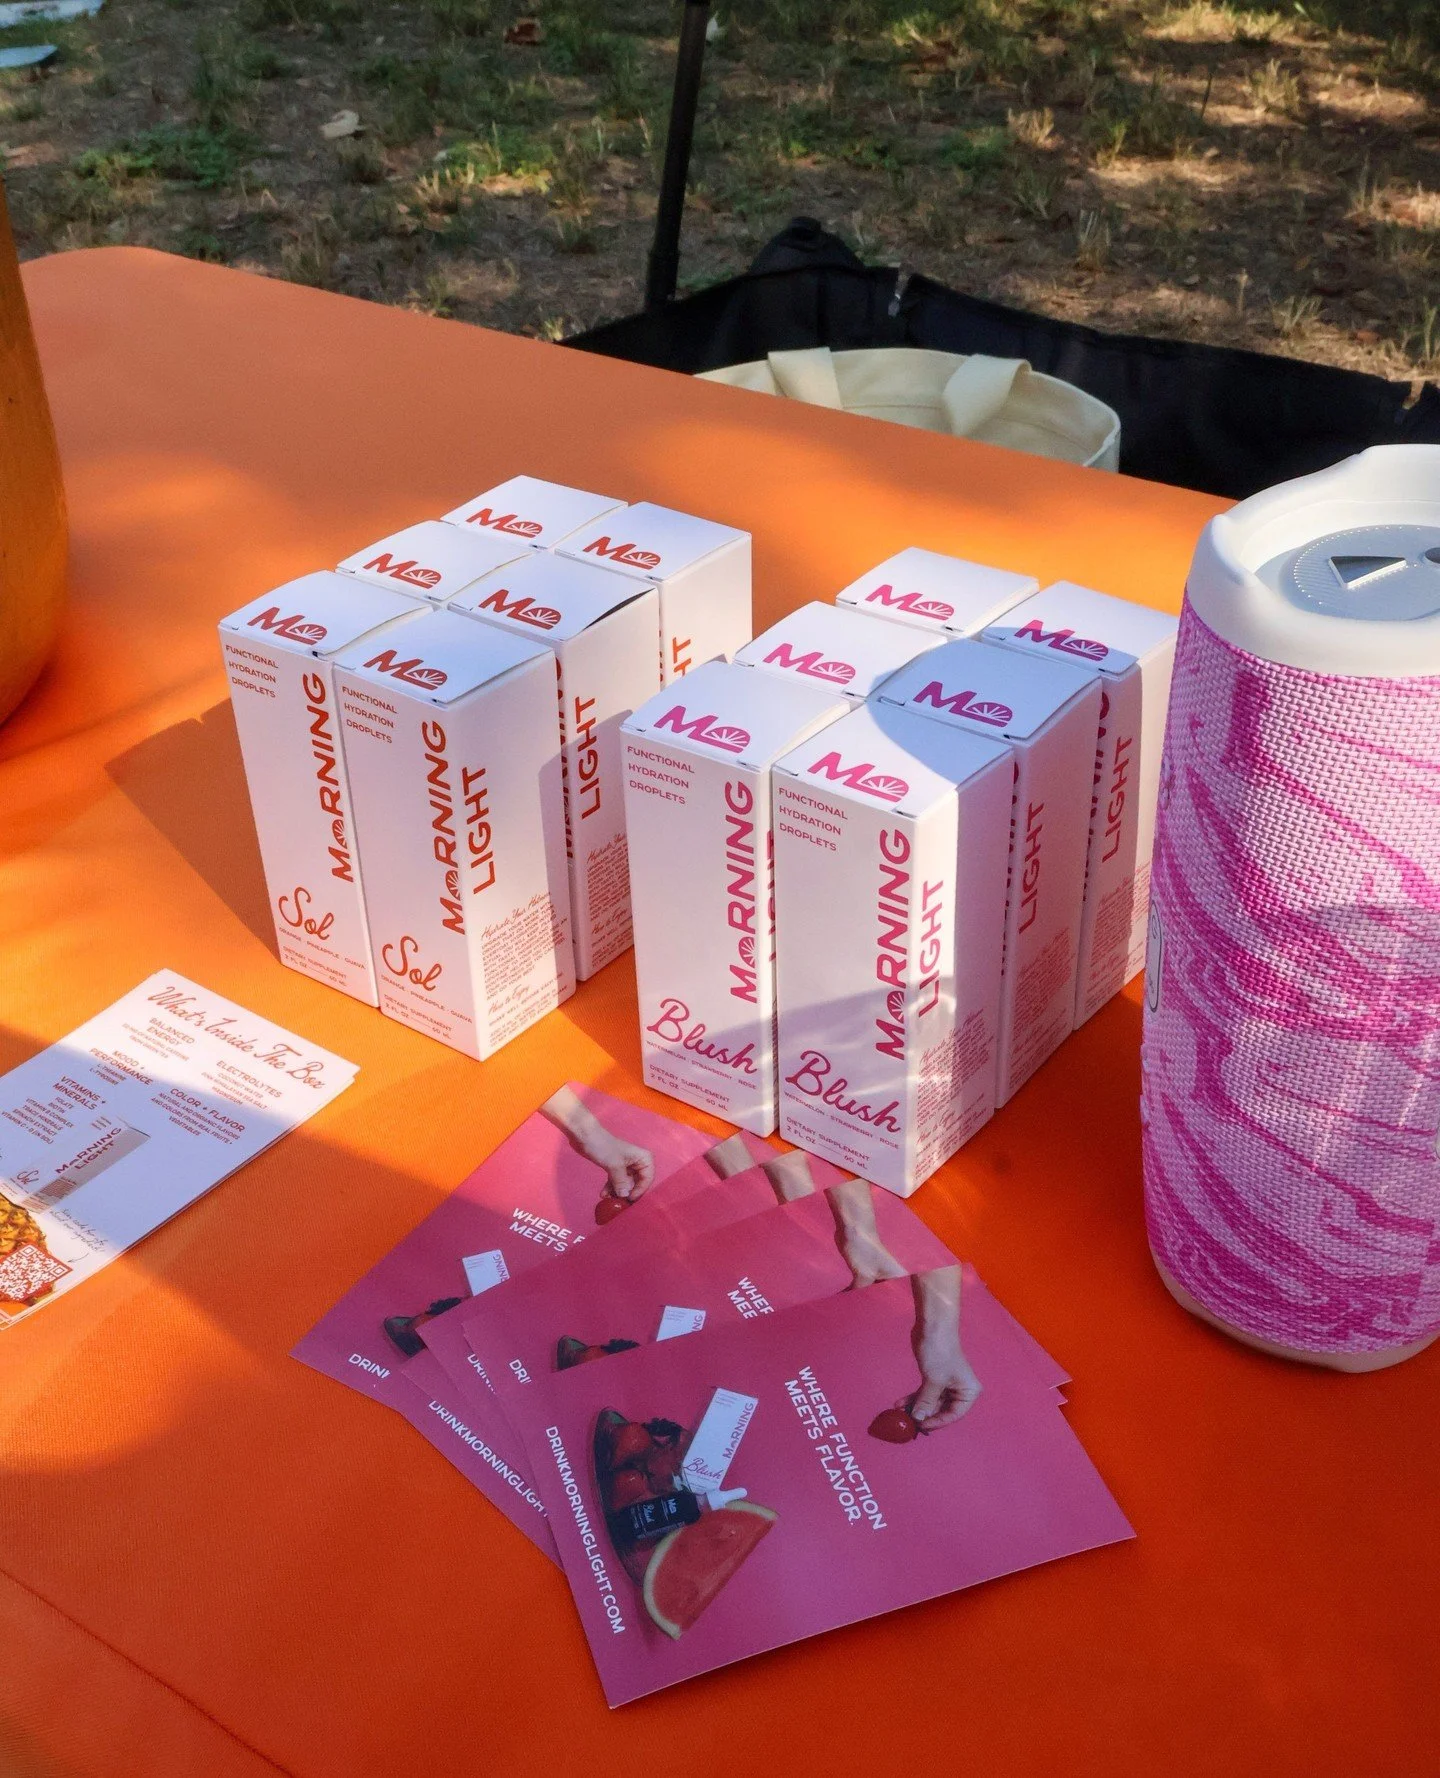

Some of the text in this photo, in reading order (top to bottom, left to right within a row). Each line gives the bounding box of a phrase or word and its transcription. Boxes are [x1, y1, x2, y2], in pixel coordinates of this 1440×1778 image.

[226, 645, 278, 668] FUNCTIONAL
[228, 661, 276, 683] HYDRATION
[232, 677, 275, 698] DROPLETS
[342, 686, 397, 714] FUNCTIONAL
[344, 703, 394, 728] HYDRATION
[347, 719, 392, 743] DROPLETS
[575, 696, 601, 820] LIGHT
[627, 746, 694, 773] FUNCTIONAL
[628, 763, 689, 788] HYDRATION
[630, 780, 685, 804] DROPLETS
[779, 788, 847, 819] FUNCTIONAL
[1101, 735, 1133, 863] LIGHT
[461, 766, 496, 894] LIGHT
[779, 806, 841, 835] HYDRATION
[780, 823, 836, 851] DROPLETS
[1018, 801, 1044, 935] LIGHT
[278, 886, 335, 940] Sol
[381, 935, 442, 991] Sol
[918, 879, 944, 1018] LIGHT
[147, 1026, 182, 1047] ENERGY
[148, 986, 326, 1089] What's Inside The Box
[150, 1017, 195, 1044] BALANCED
[646, 998, 758, 1074] Blush
[89, 1047, 153, 1085] PERFORMANCE
[112, 1051, 139, 1067] MOOD
[60, 1076, 101, 1101] VITAMINS
[216, 1060, 283, 1099] ELECTROLYTES
[650, 1064, 730, 1103] DIETARY SUPPLEMENT
[739, 1079, 756, 1089] ROSE
[785, 1050, 901, 1133] Blush
[53, 1083, 98, 1110] MINERALS
[170, 1088, 201, 1107] COLOR
[208, 1109, 245, 1132] FLAVOR
[181, 1106, 193, 1114] AND
[784, 1092, 899, 1149] WATERMELON STRAWBERRY ROSE
[787, 1117, 869, 1161] DIETARY SUPPLEMENT
[794, 1130, 803, 1138] FL
[806, 1136, 816, 1144] OZ
[74, 1140, 114, 1170] LIGHT
[509, 1221, 568, 1252] MEETS
[512, 1208, 572, 1240] WHERE
[784, 1379, 862, 1526] MEETS FLAVOR.
[799, 1366, 887, 1530] WHERE FUNCTION
[683, 1458, 725, 1479] Blush
[546, 1426, 625, 1634] DRINKMORNINGLIGHT.COM
